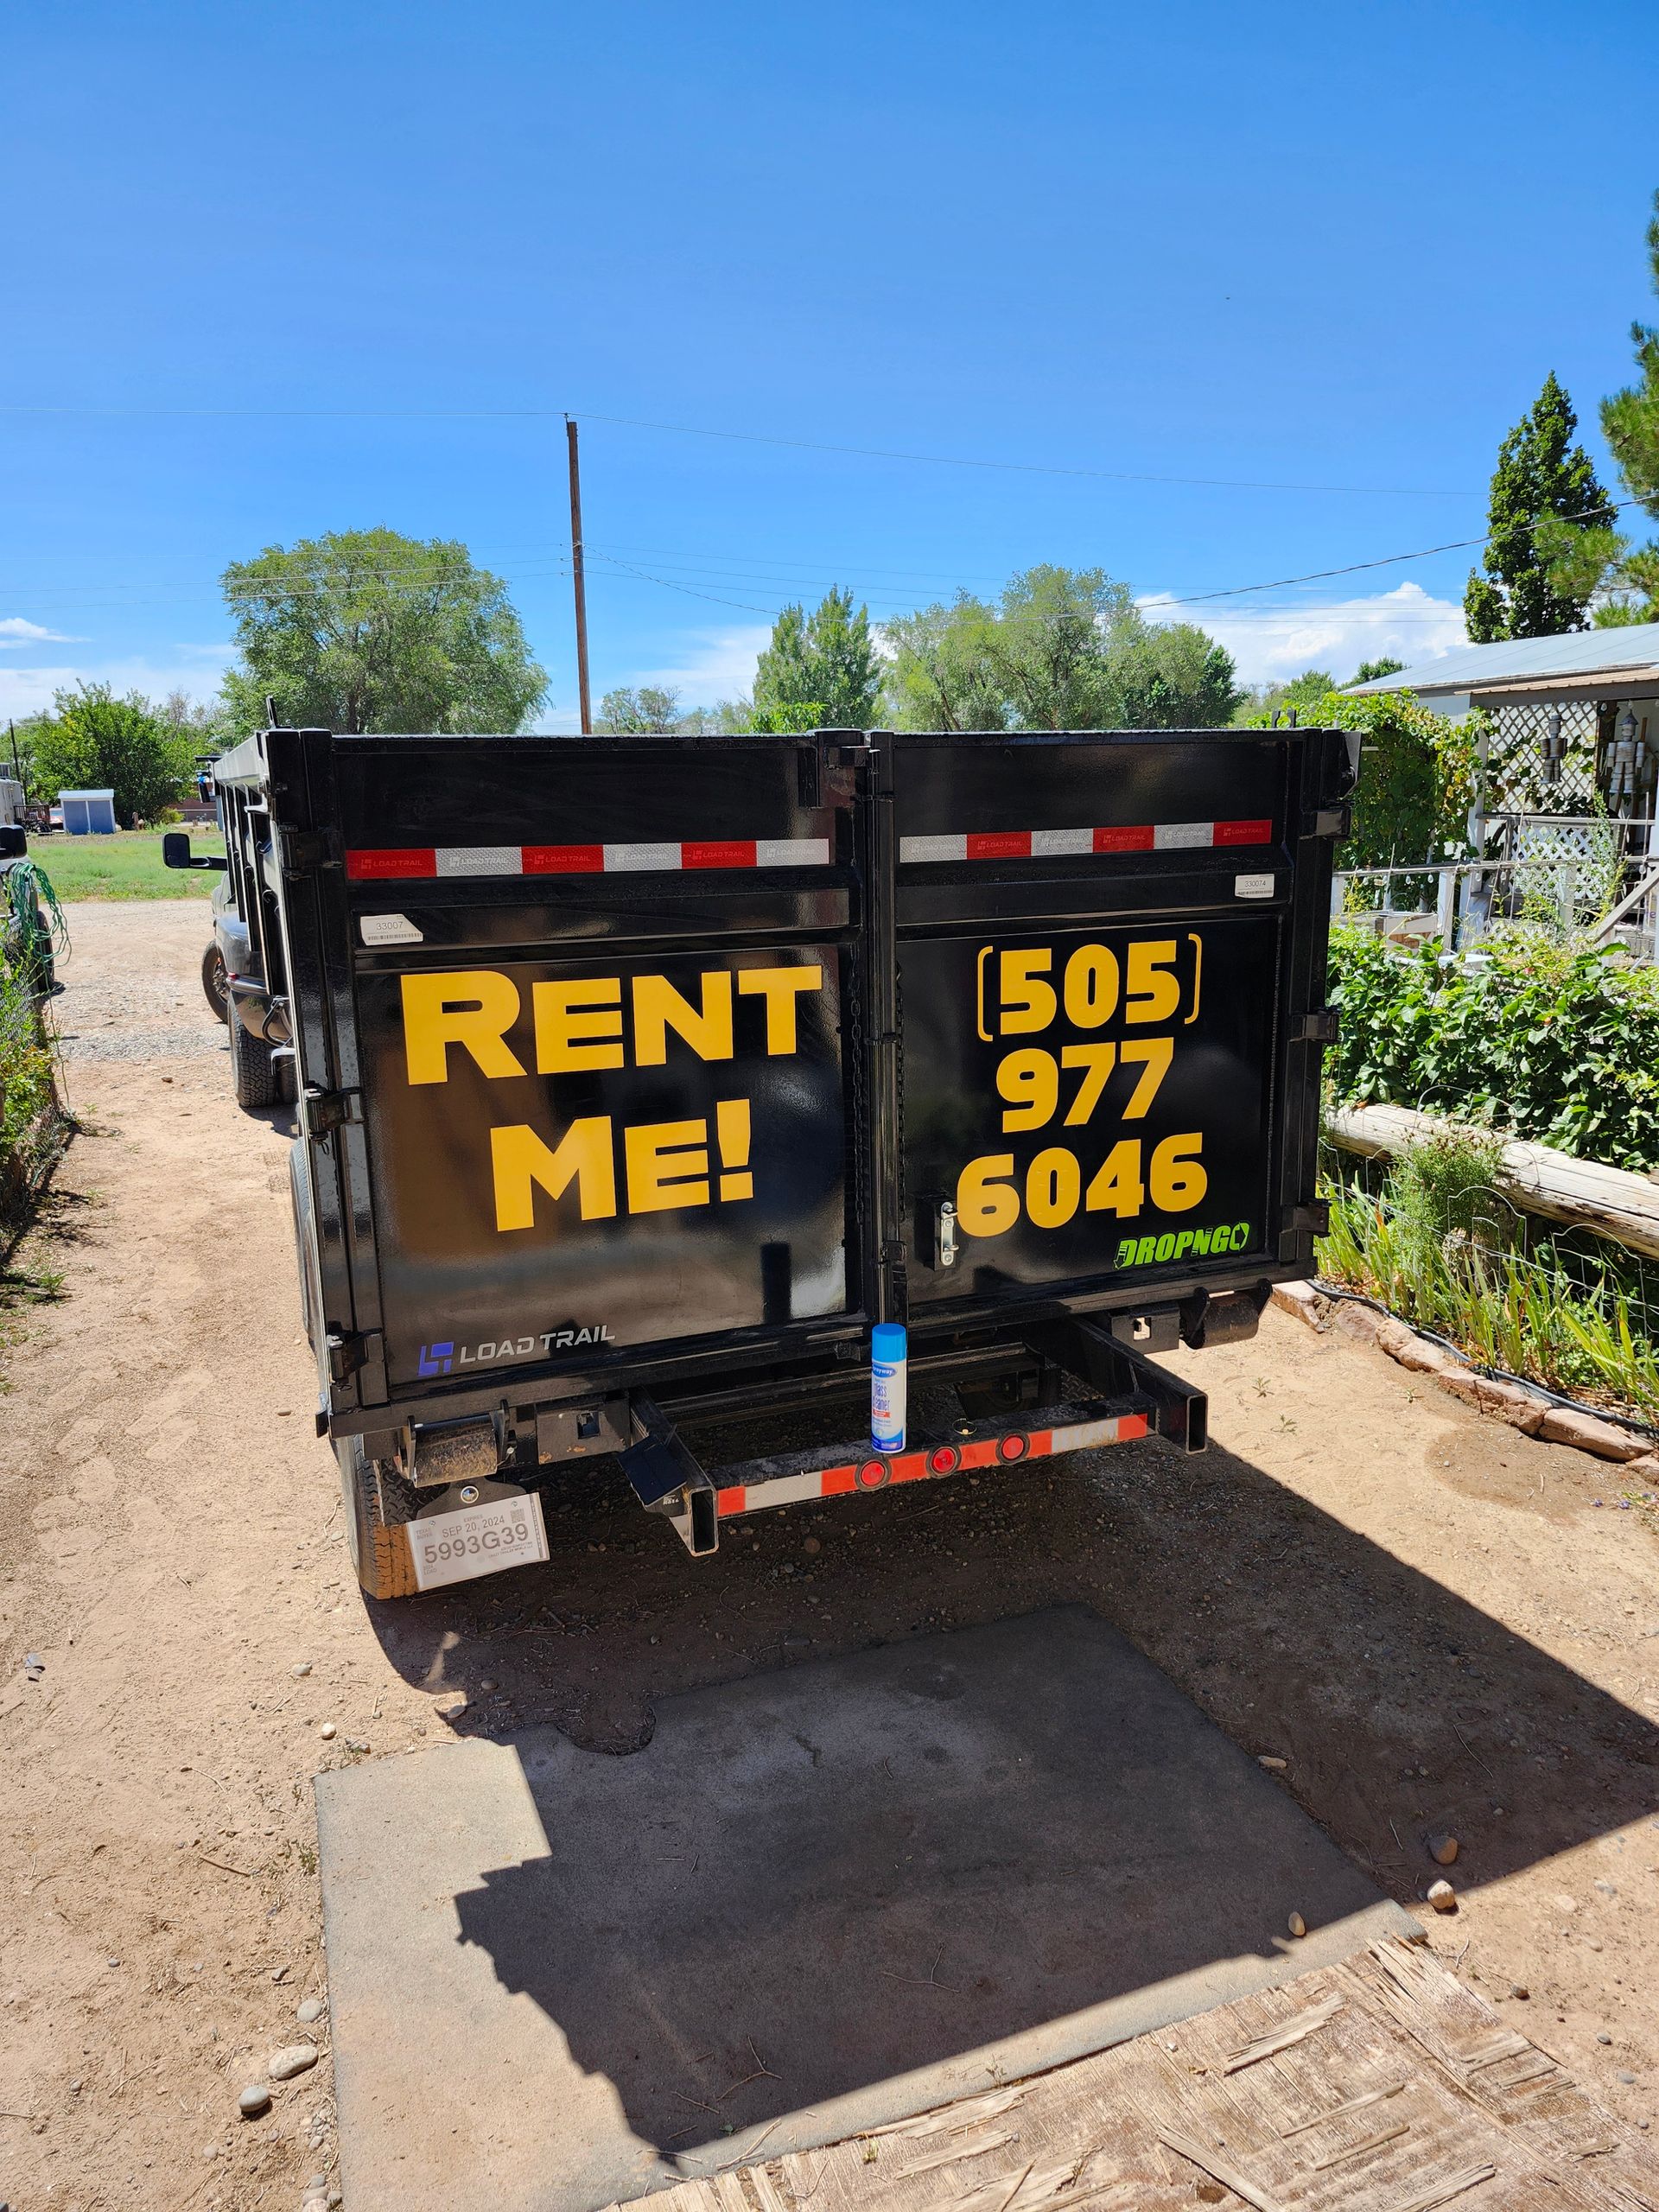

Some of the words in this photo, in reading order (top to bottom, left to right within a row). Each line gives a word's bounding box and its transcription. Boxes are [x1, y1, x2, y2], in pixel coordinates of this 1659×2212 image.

[376, 921, 404, 931] 33007
[400, 964, 822, 1085] RENT
[977, 933, 1202, 1041] (505)
[996, 1037, 1174, 1133] 977
[490, 1099, 753, 1232] ME!
[957, 1132, 1208, 1237] 6046
[460, 1336, 535, 1363] LOAD
[540, 1325, 616, 1351] TRAIL
[424, 1522, 529, 1564] 5993G39
[442, 1525, 462, 1538] SEP
[465, 1522, 480, 1533] 20,
[481, 1515, 505, 1529] 2024
